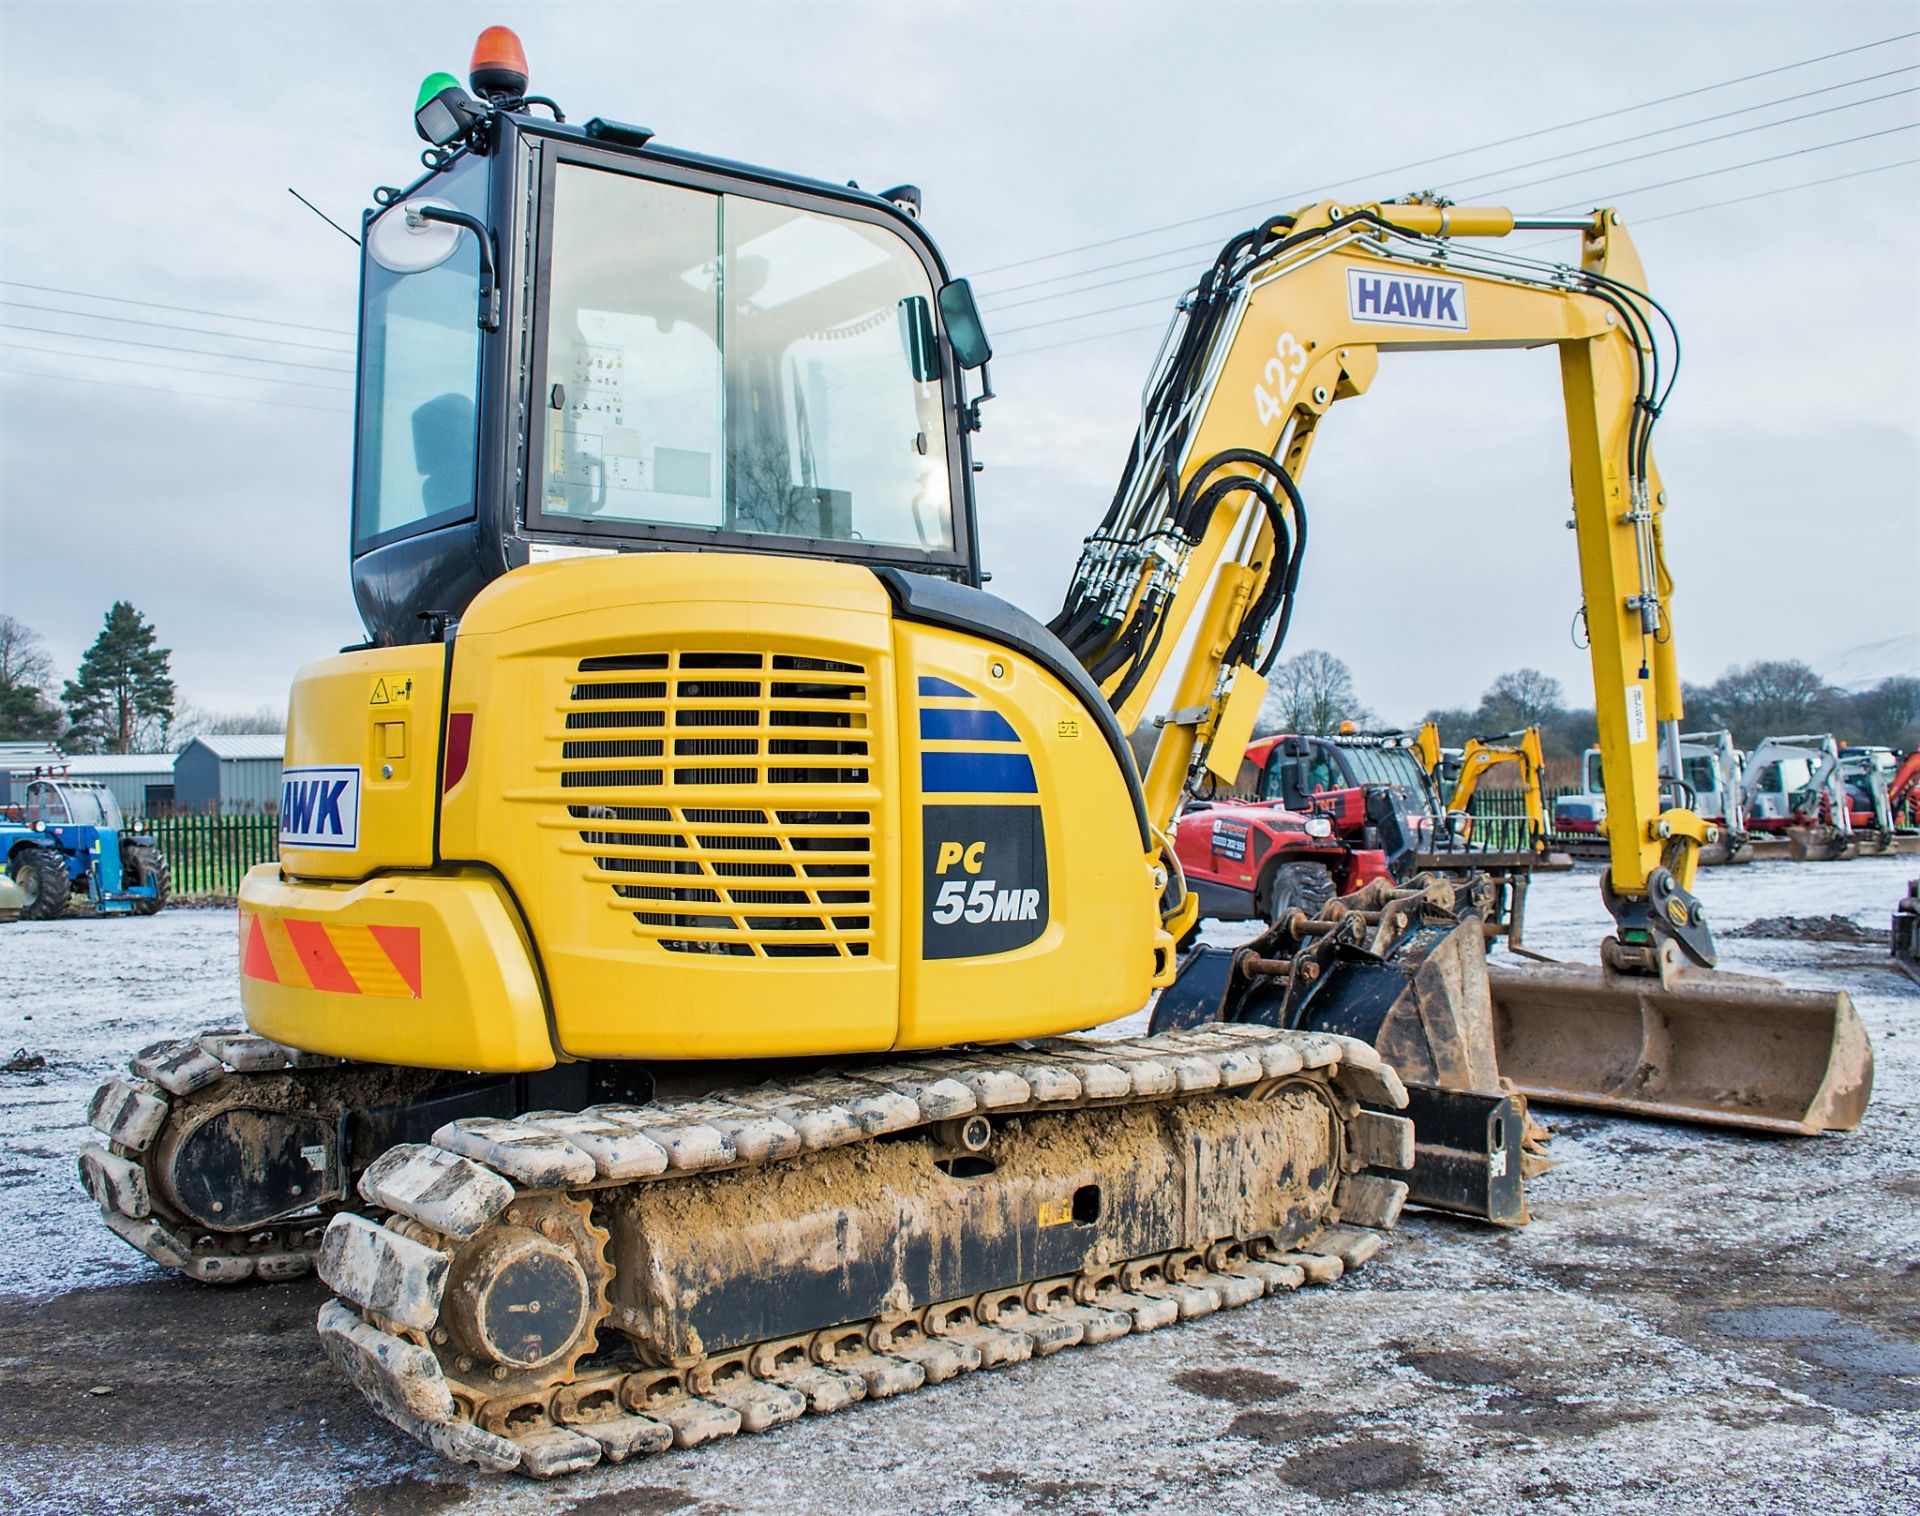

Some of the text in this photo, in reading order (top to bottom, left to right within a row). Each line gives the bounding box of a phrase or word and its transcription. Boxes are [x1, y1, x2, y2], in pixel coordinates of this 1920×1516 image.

[1357, 277, 1459, 322] HAWK
[1253, 331, 1307, 428] 423
[281, 779, 349, 836] AWK
[935, 841, 986, 875] PC
[932, 879, 1041, 925] 55MR
